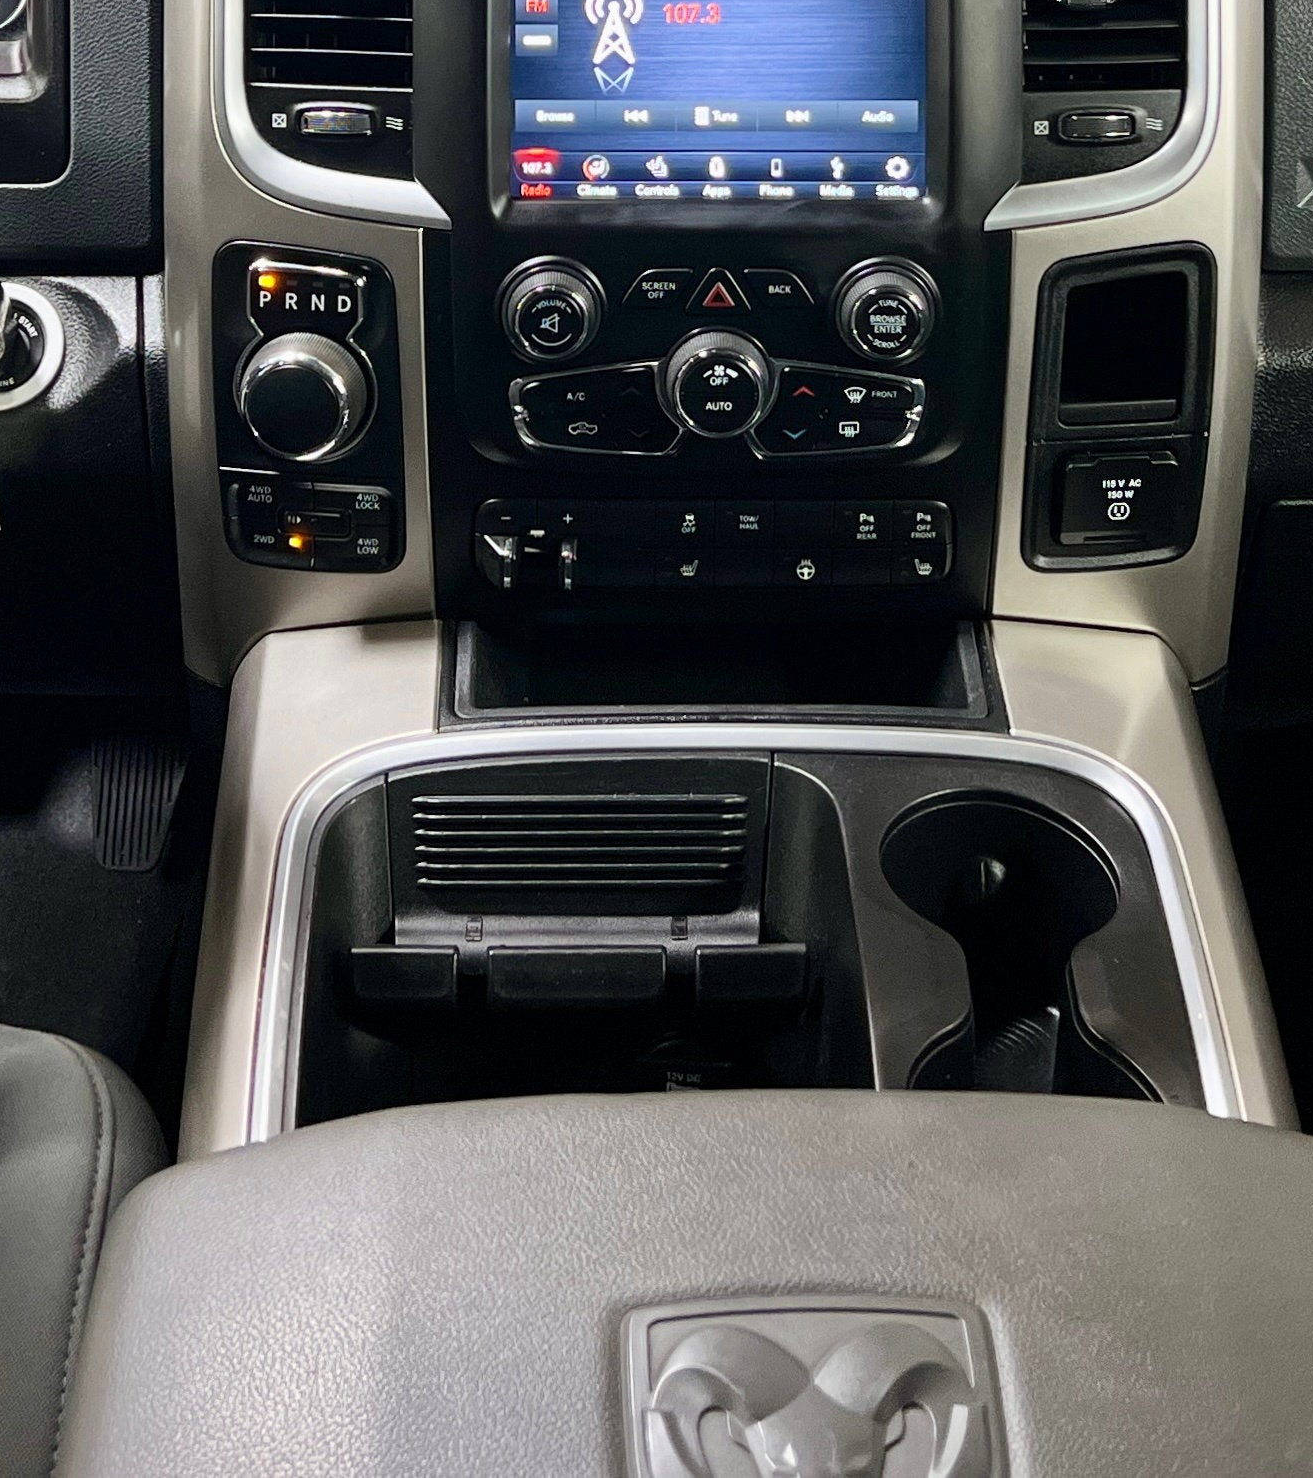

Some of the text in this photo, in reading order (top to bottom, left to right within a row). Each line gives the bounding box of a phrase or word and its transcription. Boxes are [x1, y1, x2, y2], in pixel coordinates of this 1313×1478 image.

[662, 2, 721, 24] 107.3
[712, 110, 739, 123] Tune
[861, 110, 895, 123] Audio
[520, 183, 553, 197] Radio
[576, 183, 618, 198] Climate
[635, 183, 681, 198] Controls
[702, 183, 732, 199] Apps
[758, 184, 795, 198] Phone
[819, 184, 855, 198] Media
[875, 184, 920, 200] Settings
[641, 281, 676, 291] SCREEN
[768, 285, 791, 294] BACK
[647, 291, 665, 300] OFF
[260, 291, 352, 313] P R N D
[536, 299, 566, 310] VOLUME
[878, 299, 899, 308] TUNE
[870, 314, 907, 324] BROWSE
[18, 315, 39, 337] START
[874, 324, 903, 334] ENTER
[872, 338, 901, 349] SCROLL
[709, 377, 729, 386] OFF
[566, 392, 586, 402] A/C
[871, 390, 898, 399] FRONT
[705, 401, 733, 412] AUTO
[249, 485, 271, 494] 4WD
[247, 494, 273, 503] AUTO
[356, 493, 379, 502] 4WD
[355, 502, 381, 511] LOCK
[739, 515, 759, 523] TOW/
[681, 526, 696, 534] OFF
[859, 525, 875, 533] OFF
[916, 524, 931, 532] OFF
[253, 535, 275, 544] 2WD
[856, 532, 877, 540] REAR
[911, 531, 936, 539] FRONT
[357, 538, 379, 546] 4WD
[357, 546, 379, 555] LOW
